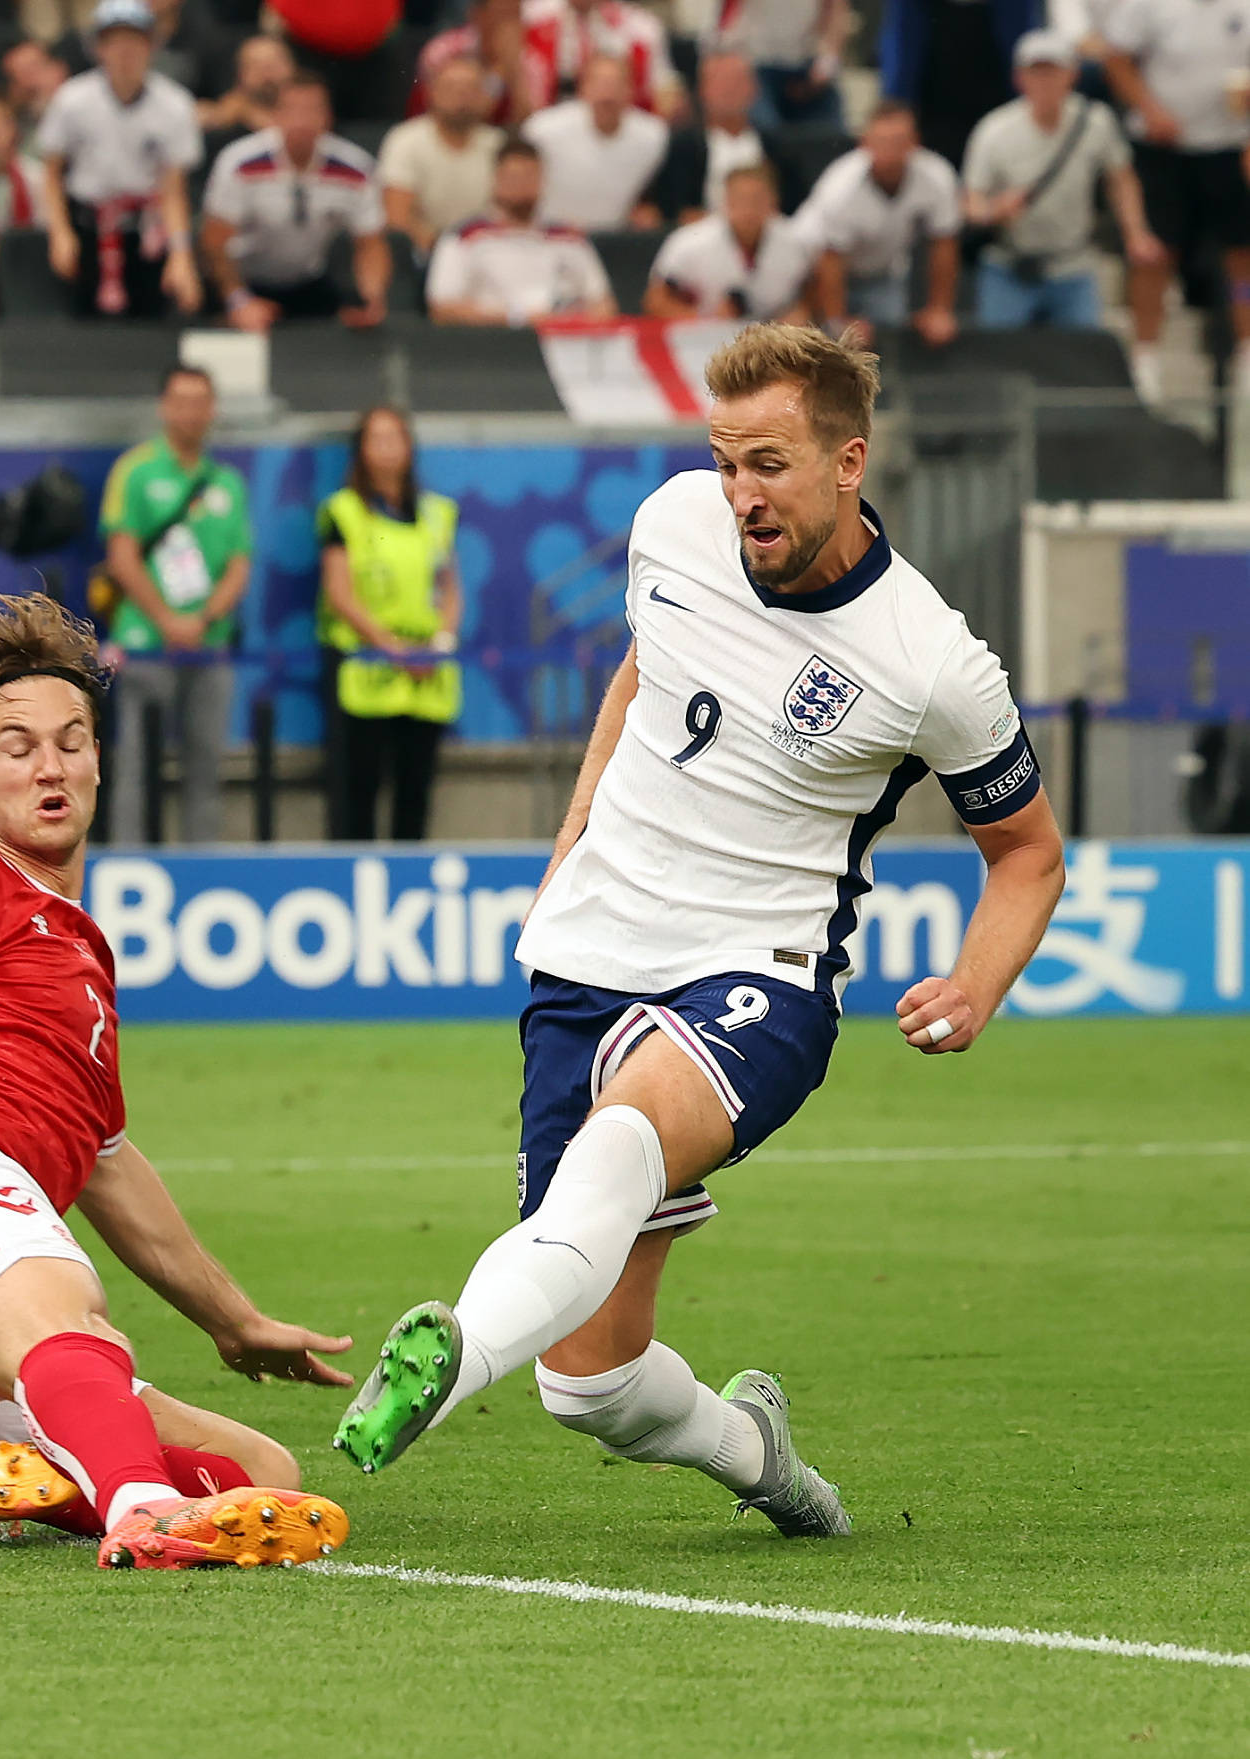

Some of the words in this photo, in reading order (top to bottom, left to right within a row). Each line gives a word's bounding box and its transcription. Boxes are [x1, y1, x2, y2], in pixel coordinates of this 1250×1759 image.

[669, 690, 723, 770] 9
[771, 719, 816, 751] DENMARK
[713, 984, 771, 1033] 9
